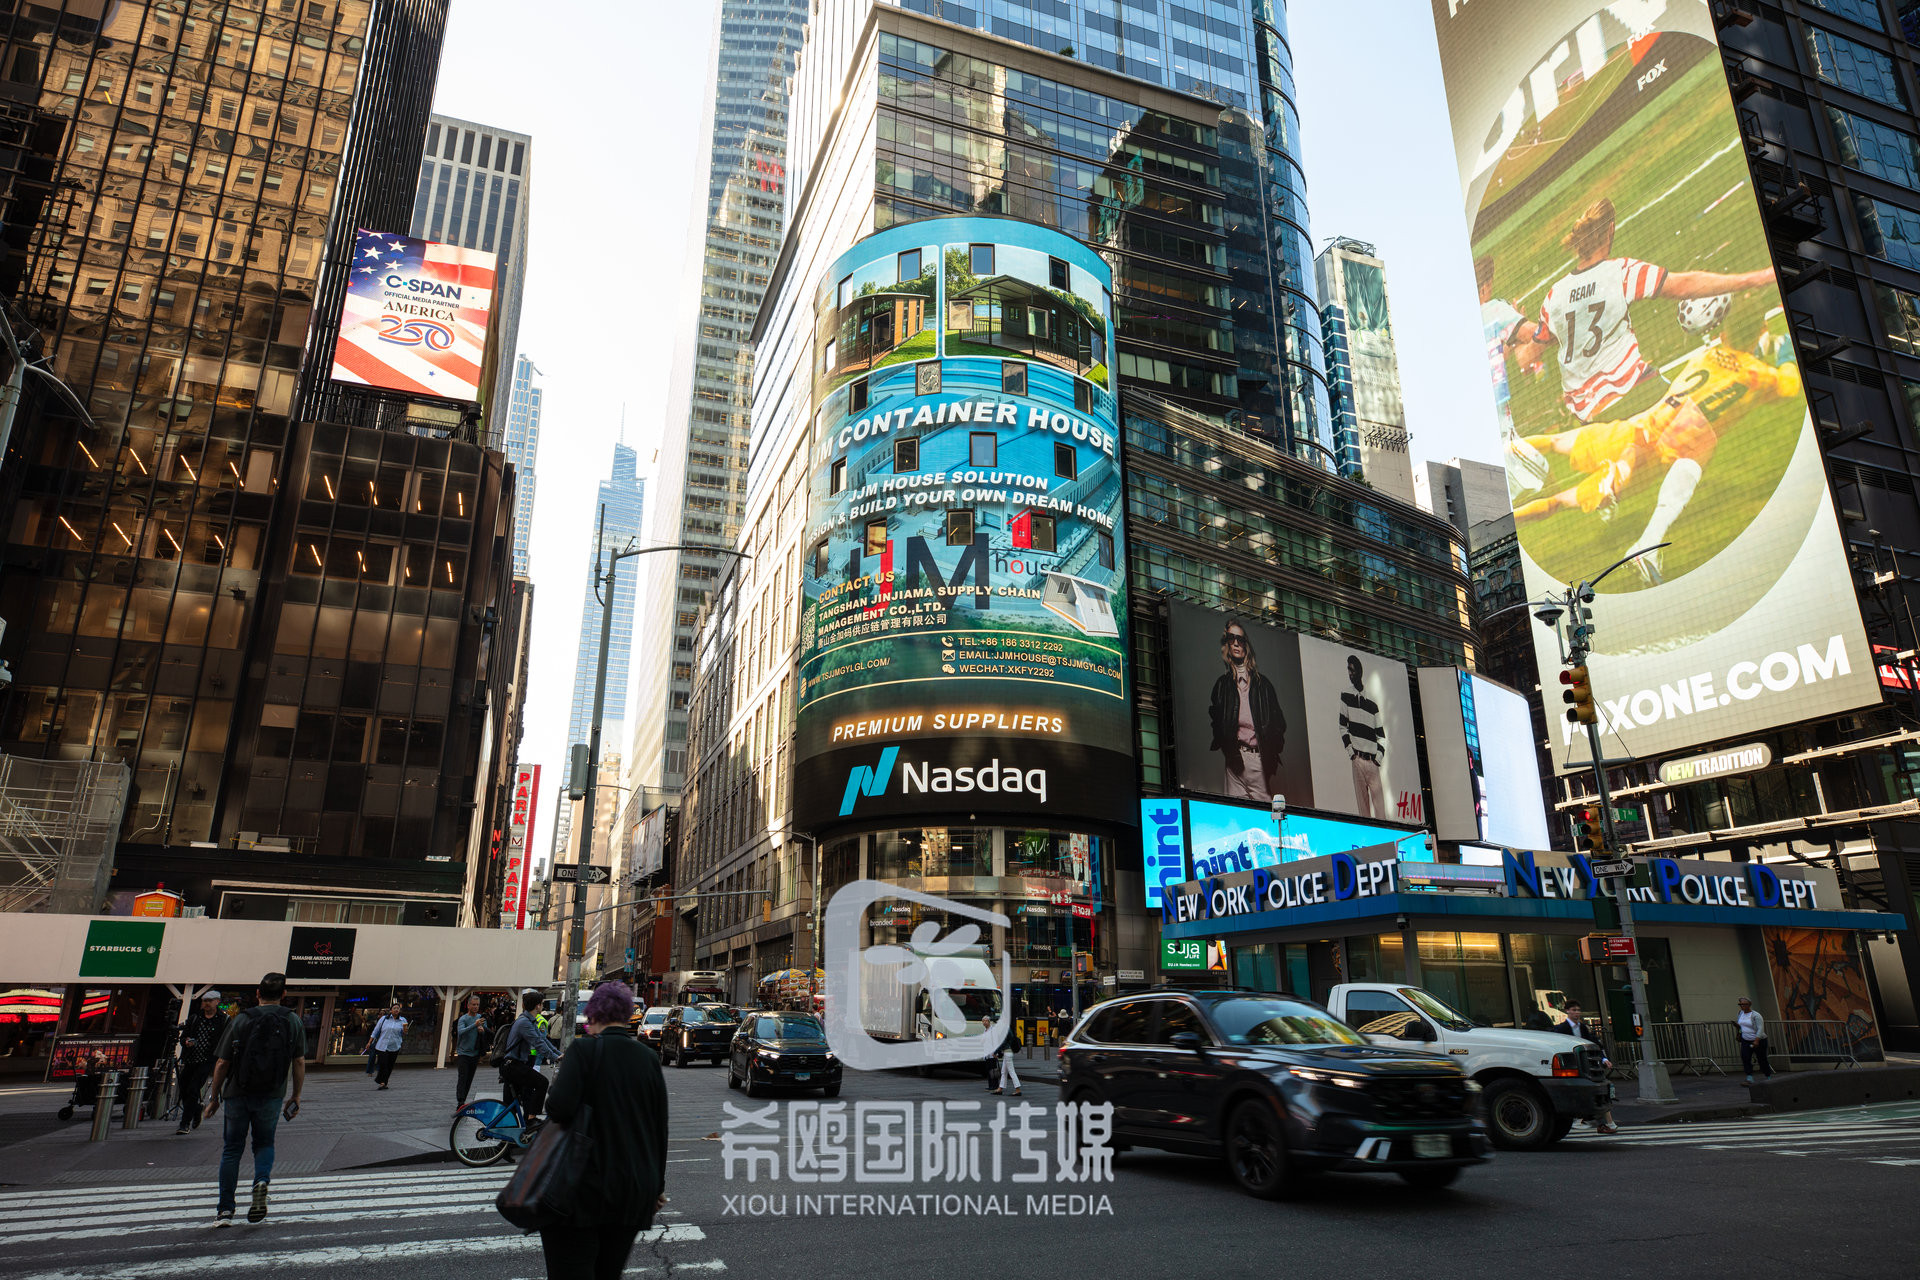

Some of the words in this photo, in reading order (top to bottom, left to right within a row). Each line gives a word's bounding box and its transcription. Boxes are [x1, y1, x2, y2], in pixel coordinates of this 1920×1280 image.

[1637, 58, 1668, 92] FOX
[384, 291, 411, 300] OFFICIAL
[412, 295, 432, 304] MEDIA
[432, 299, 460, 309] PARTNER
[385, 274, 462, 301] C-SPAN
[1569, 281, 1597, 303] REAM
[383, 301, 455, 322] AMERICA
[378, 314, 455, 351] 250
[1564, 300, 1606, 364] 13
[838, 401, 1018, 449] CONTAINER
[1027, 408, 1114, 456] HOUSE
[848, 482, 879, 503] JJM
[882, 472, 947, 492] HOUSE
[951, 471, 1048, 490] SOLUTION
[837, 511, 847, 525] &
[849, 496, 897, 520] BUILD
[903, 489, 956, 506] YOUR
[961, 488, 1006, 503] OWN
[1012, 491, 1074, 514] DREAM
[1076, 503, 1114, 529] HOME
[818, 597, 868, 622] TANGSHAN
[871, 587, 934, 604] JINJIAMA
[937, 585, 993, 596] SUPPLY
[997, 586, 1041, 600] CHAIN
[819, 575, 871, 604] CONTACT
[875, 571, 895, 584] US
[818, 608, 886, 638] MANAGEMENT
[889, 601, 946, 616] CO.,LTD.
[958, 637, 998, 647] TEL:+86
[1000, 638, 1017, 648] 186
[1019, 640, 1041, 650] 3312
[1043, 642, 1064, 653] 2292
[959, 664, 1055, 678] WECHAT:XKFY2292
[832, 715, 923, 743] PREMIUM
[932, 713, 1063, 733] SUPPLIERS
[902, 758, 1048, 804] Nasdaq
[513, 772, 531, 825] PARK
[1396, 790, 1422, 822] H&M
[1147, 808, 1182, 897] hint
[1192, 841, 1252, 880] hint
[1595, 865, 1609, 874] ONE
[1614, 863, 1629, 872] WAY
[503, 857, 521, 912] PARK
[561, 869, 578, 878] ONE
[1161, 885, 1200, 925] NEW
[1199, 877, 1251, 919] YORK
[1253, 869, 1326, 911] POLICE
[1331, 853, 1397, 901] DEPT
[1502, 847, 1576, 898] NEW
[1655, 858, 1749, 906] POLICE
[1748, 863, 1817, 909] DEPT
[1026, 906, 1047, 914] Nasdaq
[89, 945, 142, 953] STARBUCKS
[1167, 943, 1200, 959] suja
